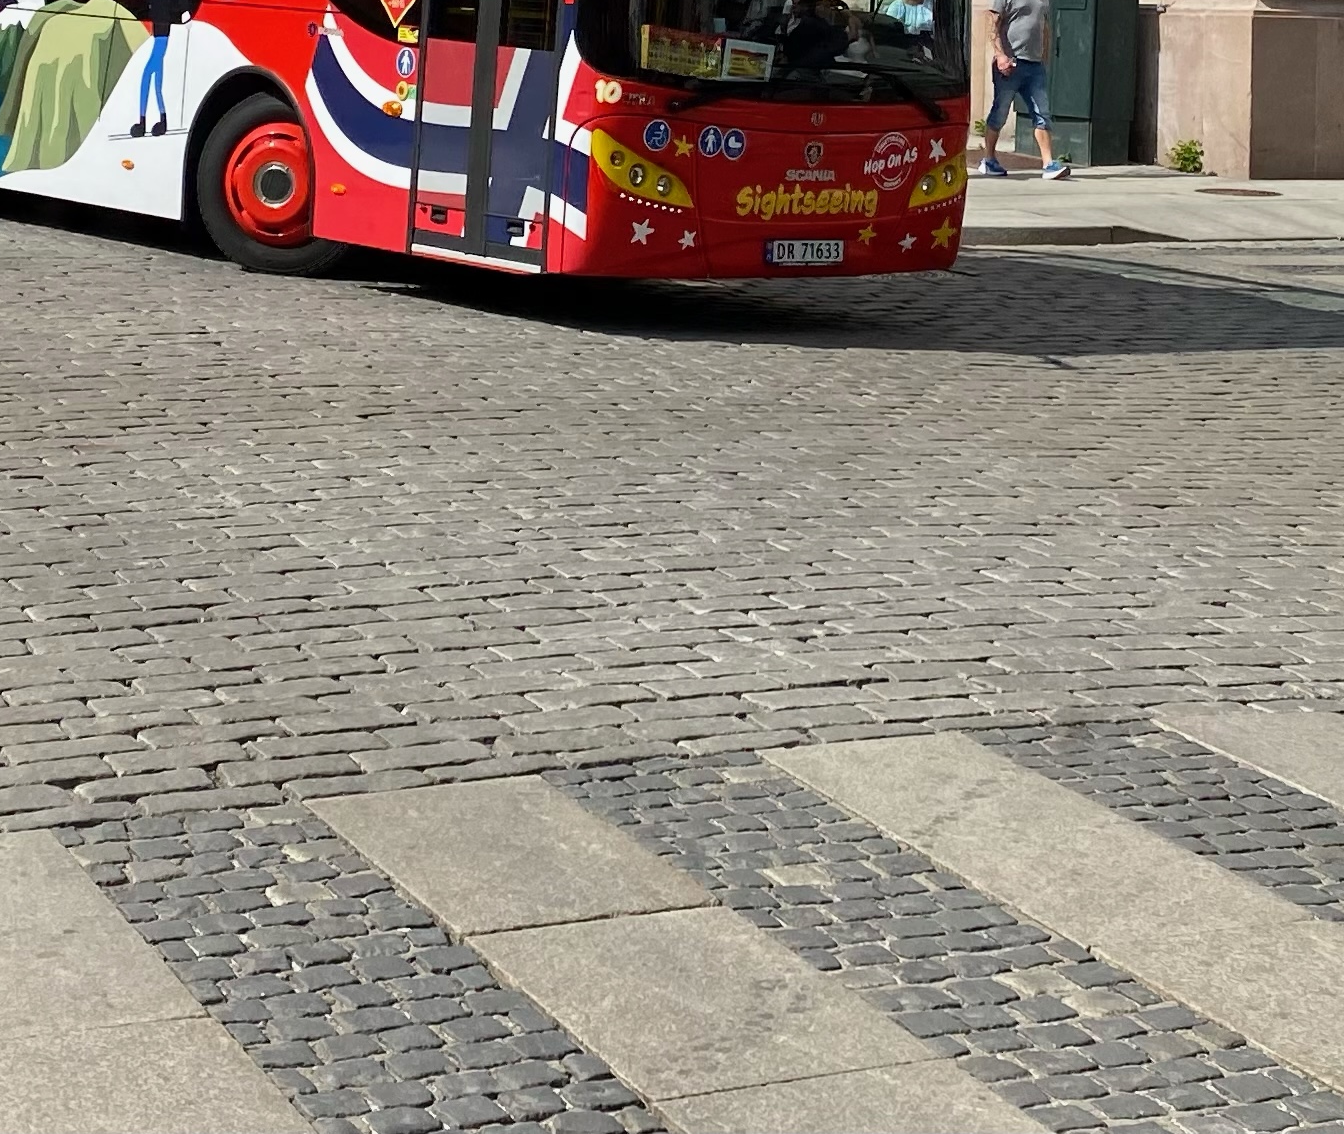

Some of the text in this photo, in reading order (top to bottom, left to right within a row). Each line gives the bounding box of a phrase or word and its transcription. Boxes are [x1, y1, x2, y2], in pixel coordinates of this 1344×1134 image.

[594, 78, 623, 104] 10
[864, 146, 918, 175] Hop On AS
[784, 169, 836, 182] SCANIA
[735, 183, 879, 221] Sightseeing
[777, 242, 840, 260] DR 71633
